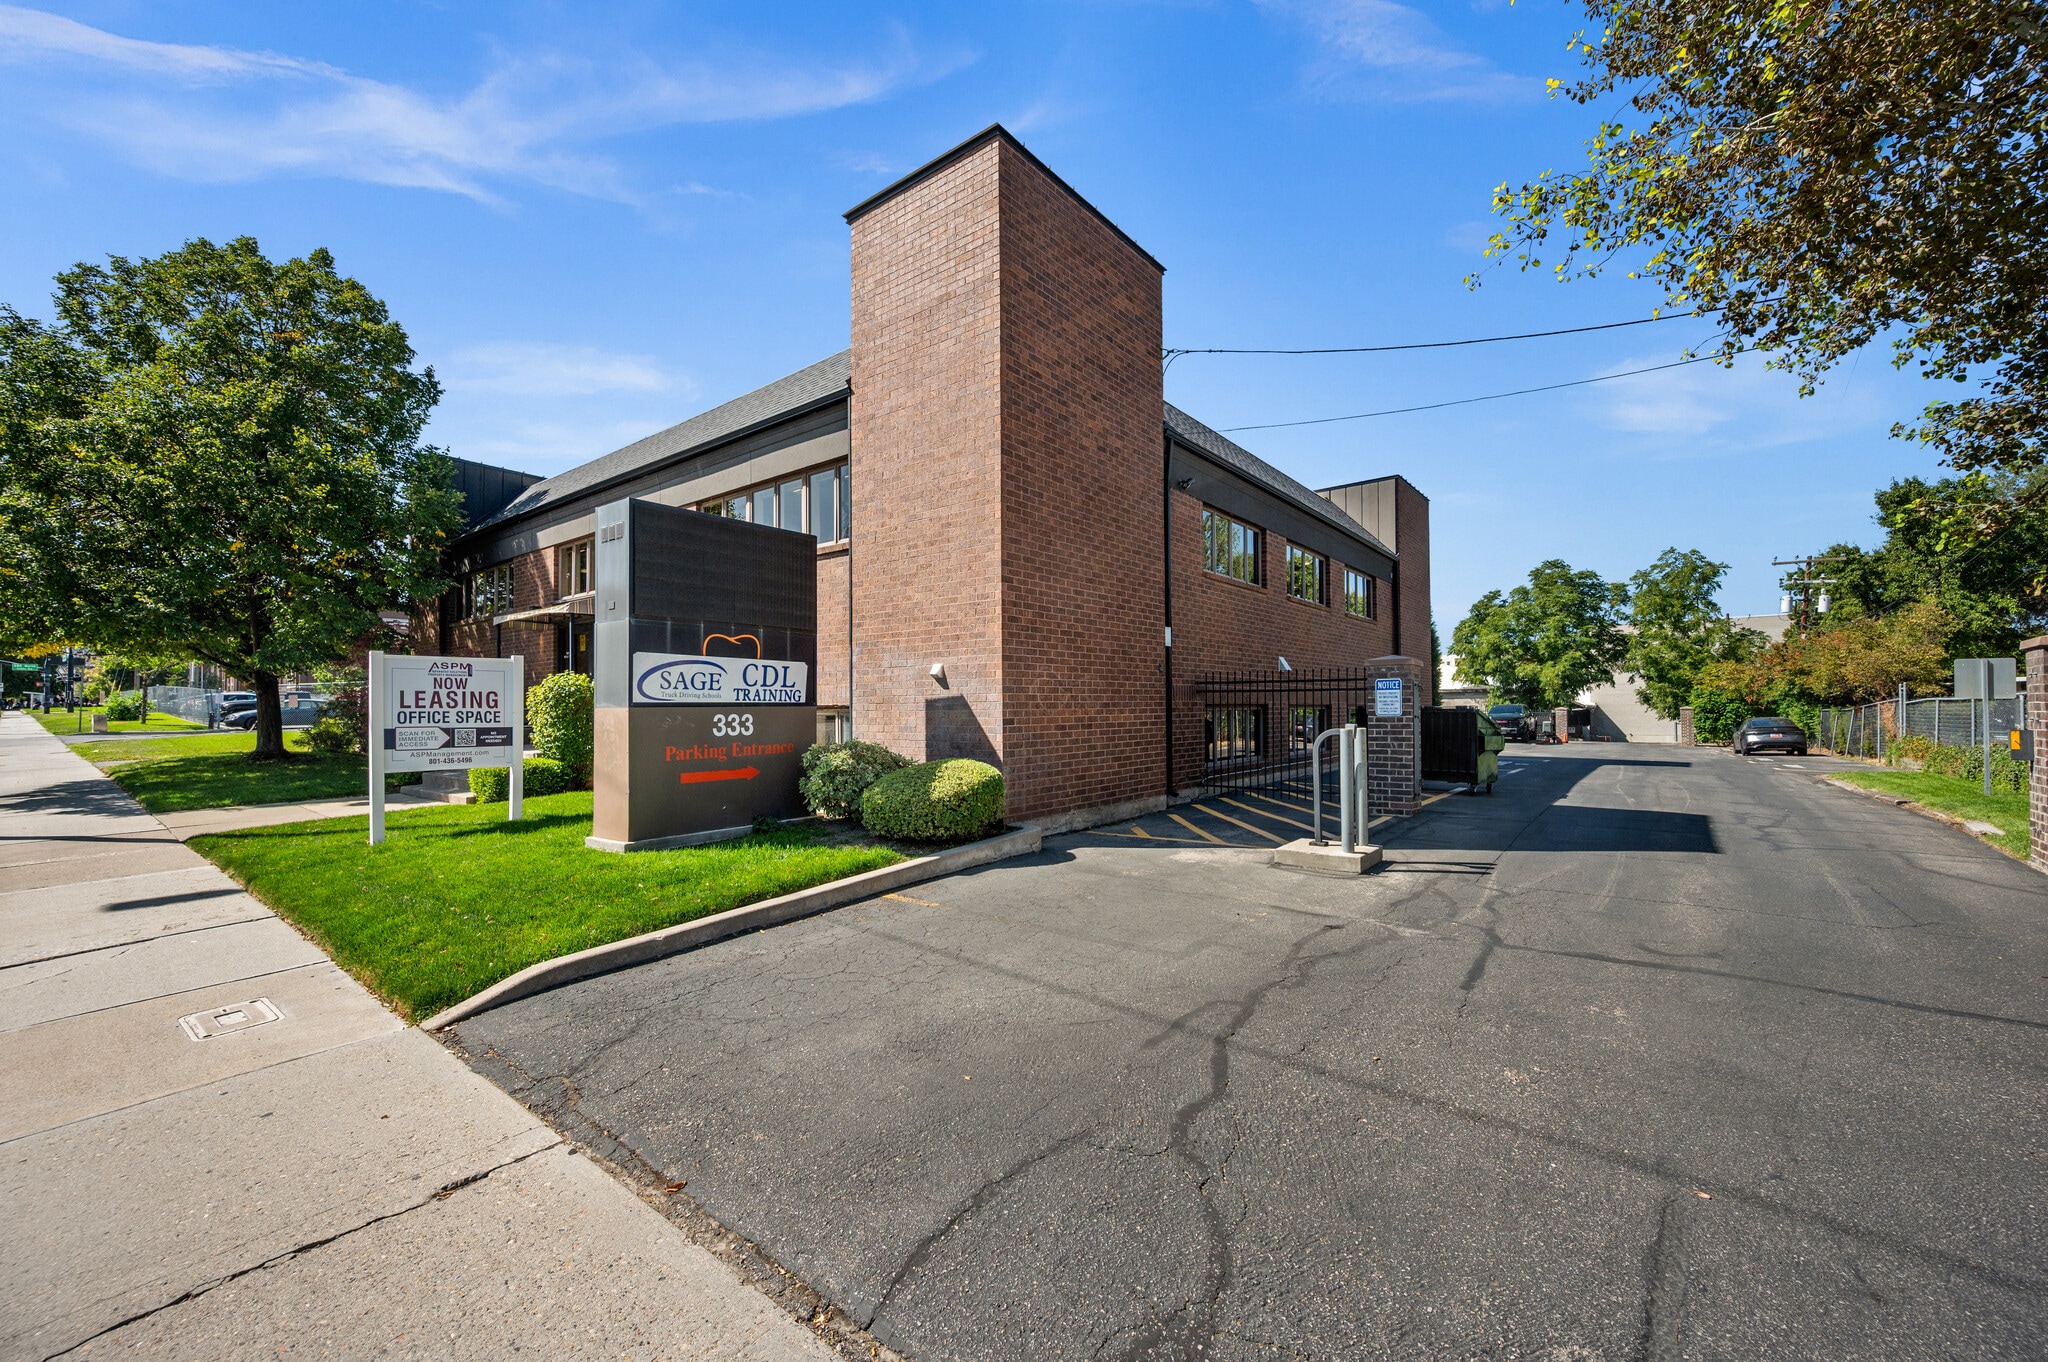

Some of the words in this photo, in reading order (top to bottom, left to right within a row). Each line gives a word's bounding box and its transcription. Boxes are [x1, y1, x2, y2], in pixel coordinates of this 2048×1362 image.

[428, 662, 472, 677] ASPM
[742, 663, 797, 689] CDL
[433, 677, 468, 690] NOW
[659, 670, 722, 692] SAGE
[1377, 681, 1400, 689] NOTICE
[399, 690, 499, 709] LEASING
[733, 688, 802, 703] TRAINING
[397, 710, 450, 724] OFFICE
[455, 710, 501, 724] SPACE
[712, 713, 754, 737] 333
[410, 750, 490, 758] ASPManagement.com
[664, 745, 727, 762] Parking
[731, 742, 795, 757] Entrance
